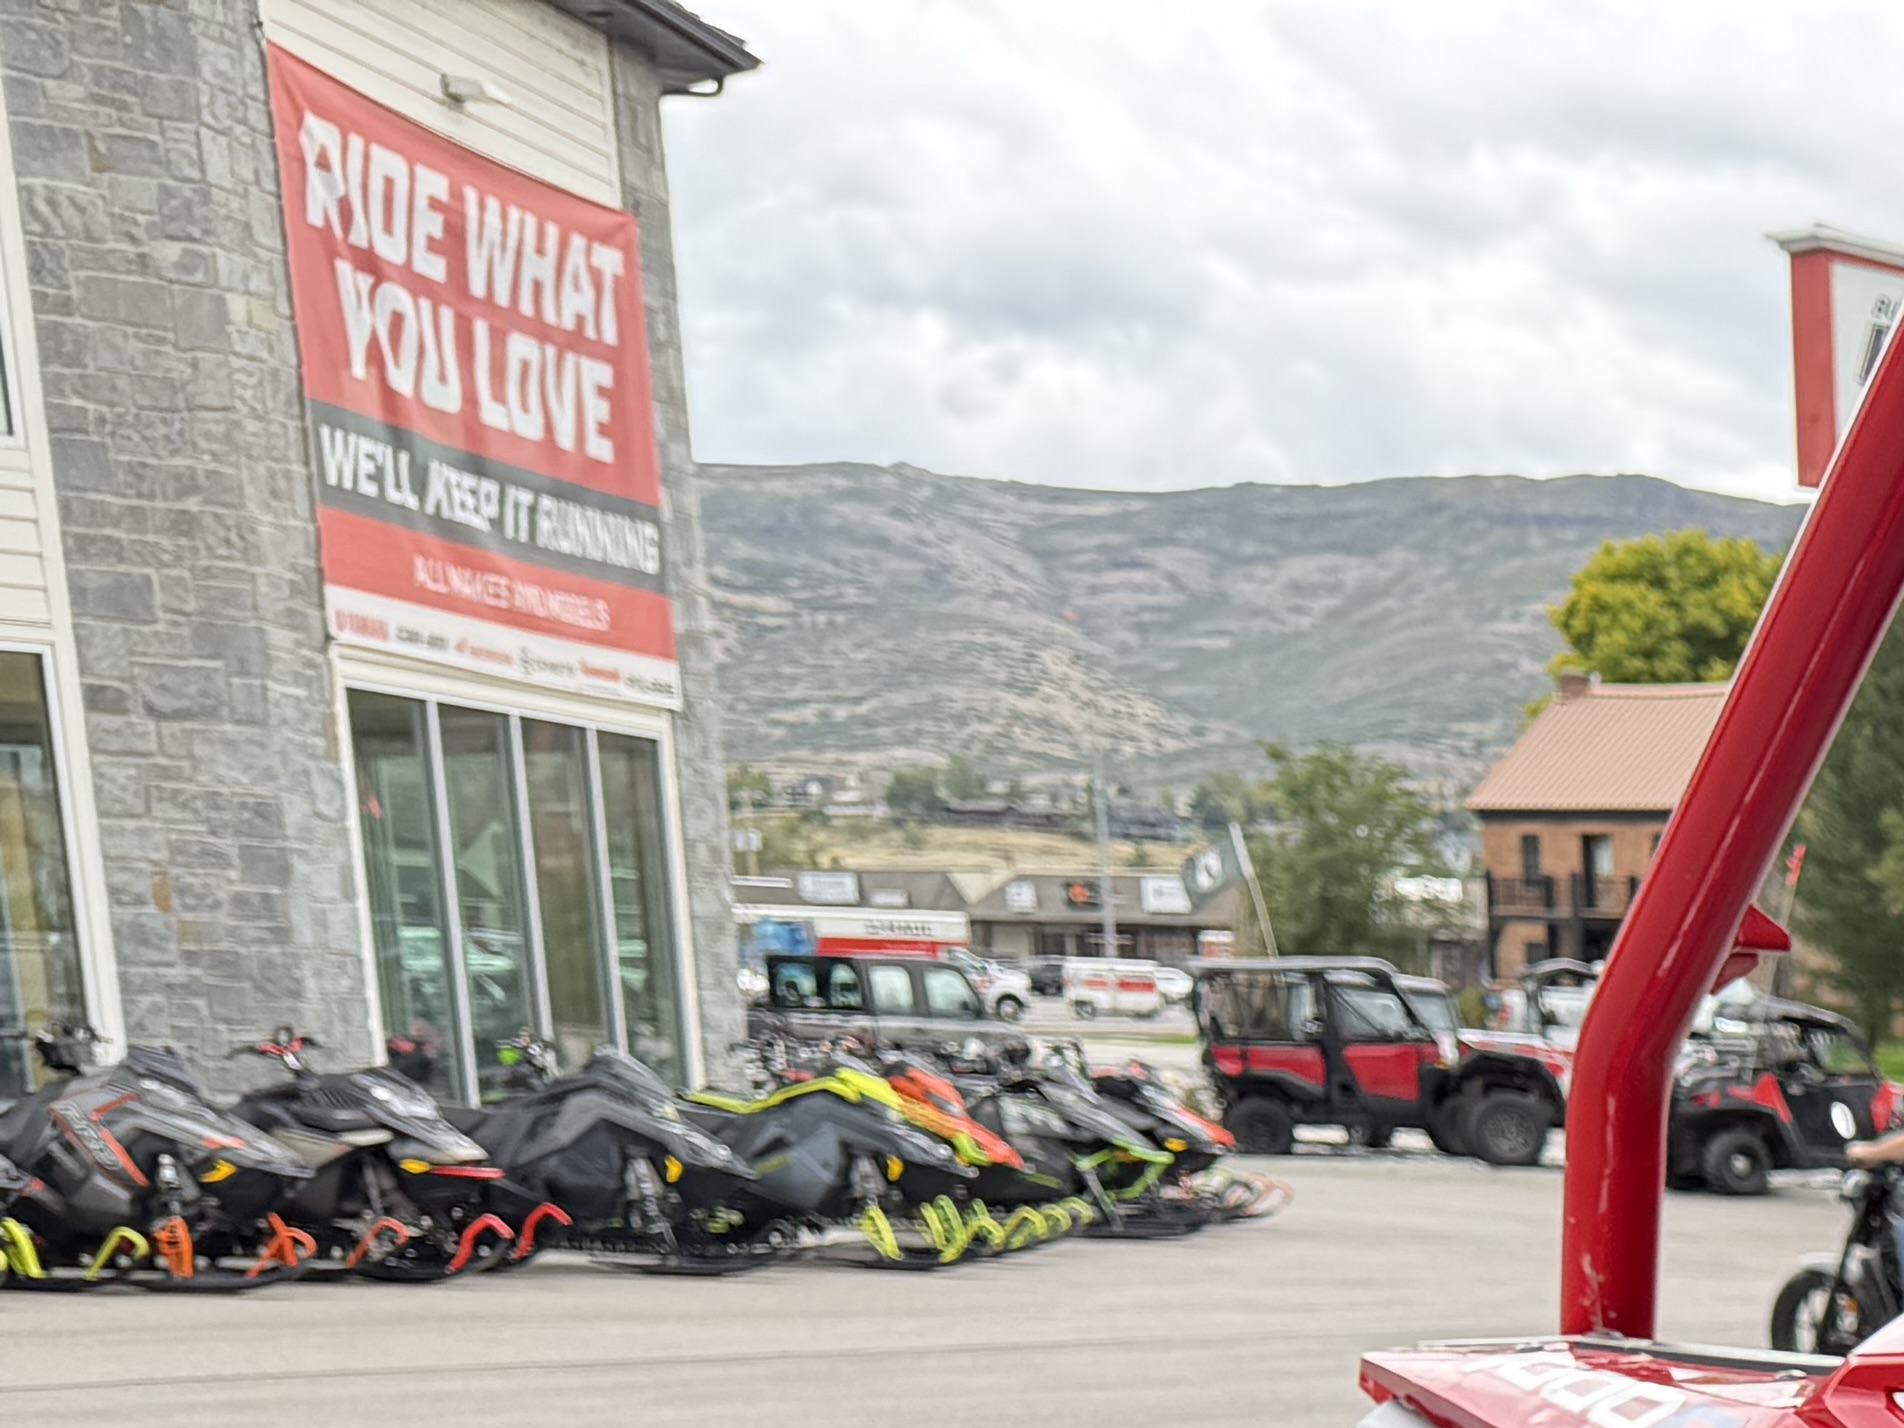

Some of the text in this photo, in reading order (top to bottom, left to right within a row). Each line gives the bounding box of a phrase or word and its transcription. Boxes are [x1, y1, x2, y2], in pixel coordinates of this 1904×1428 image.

[299, 109, 624, 346] RIDE WHAT
[334, 257, 614, 464] YOU LOVE
[319, 424, 660, 575] WE'LL KEEP IT RUNNING
[413, 554, 447, 594] ALL
